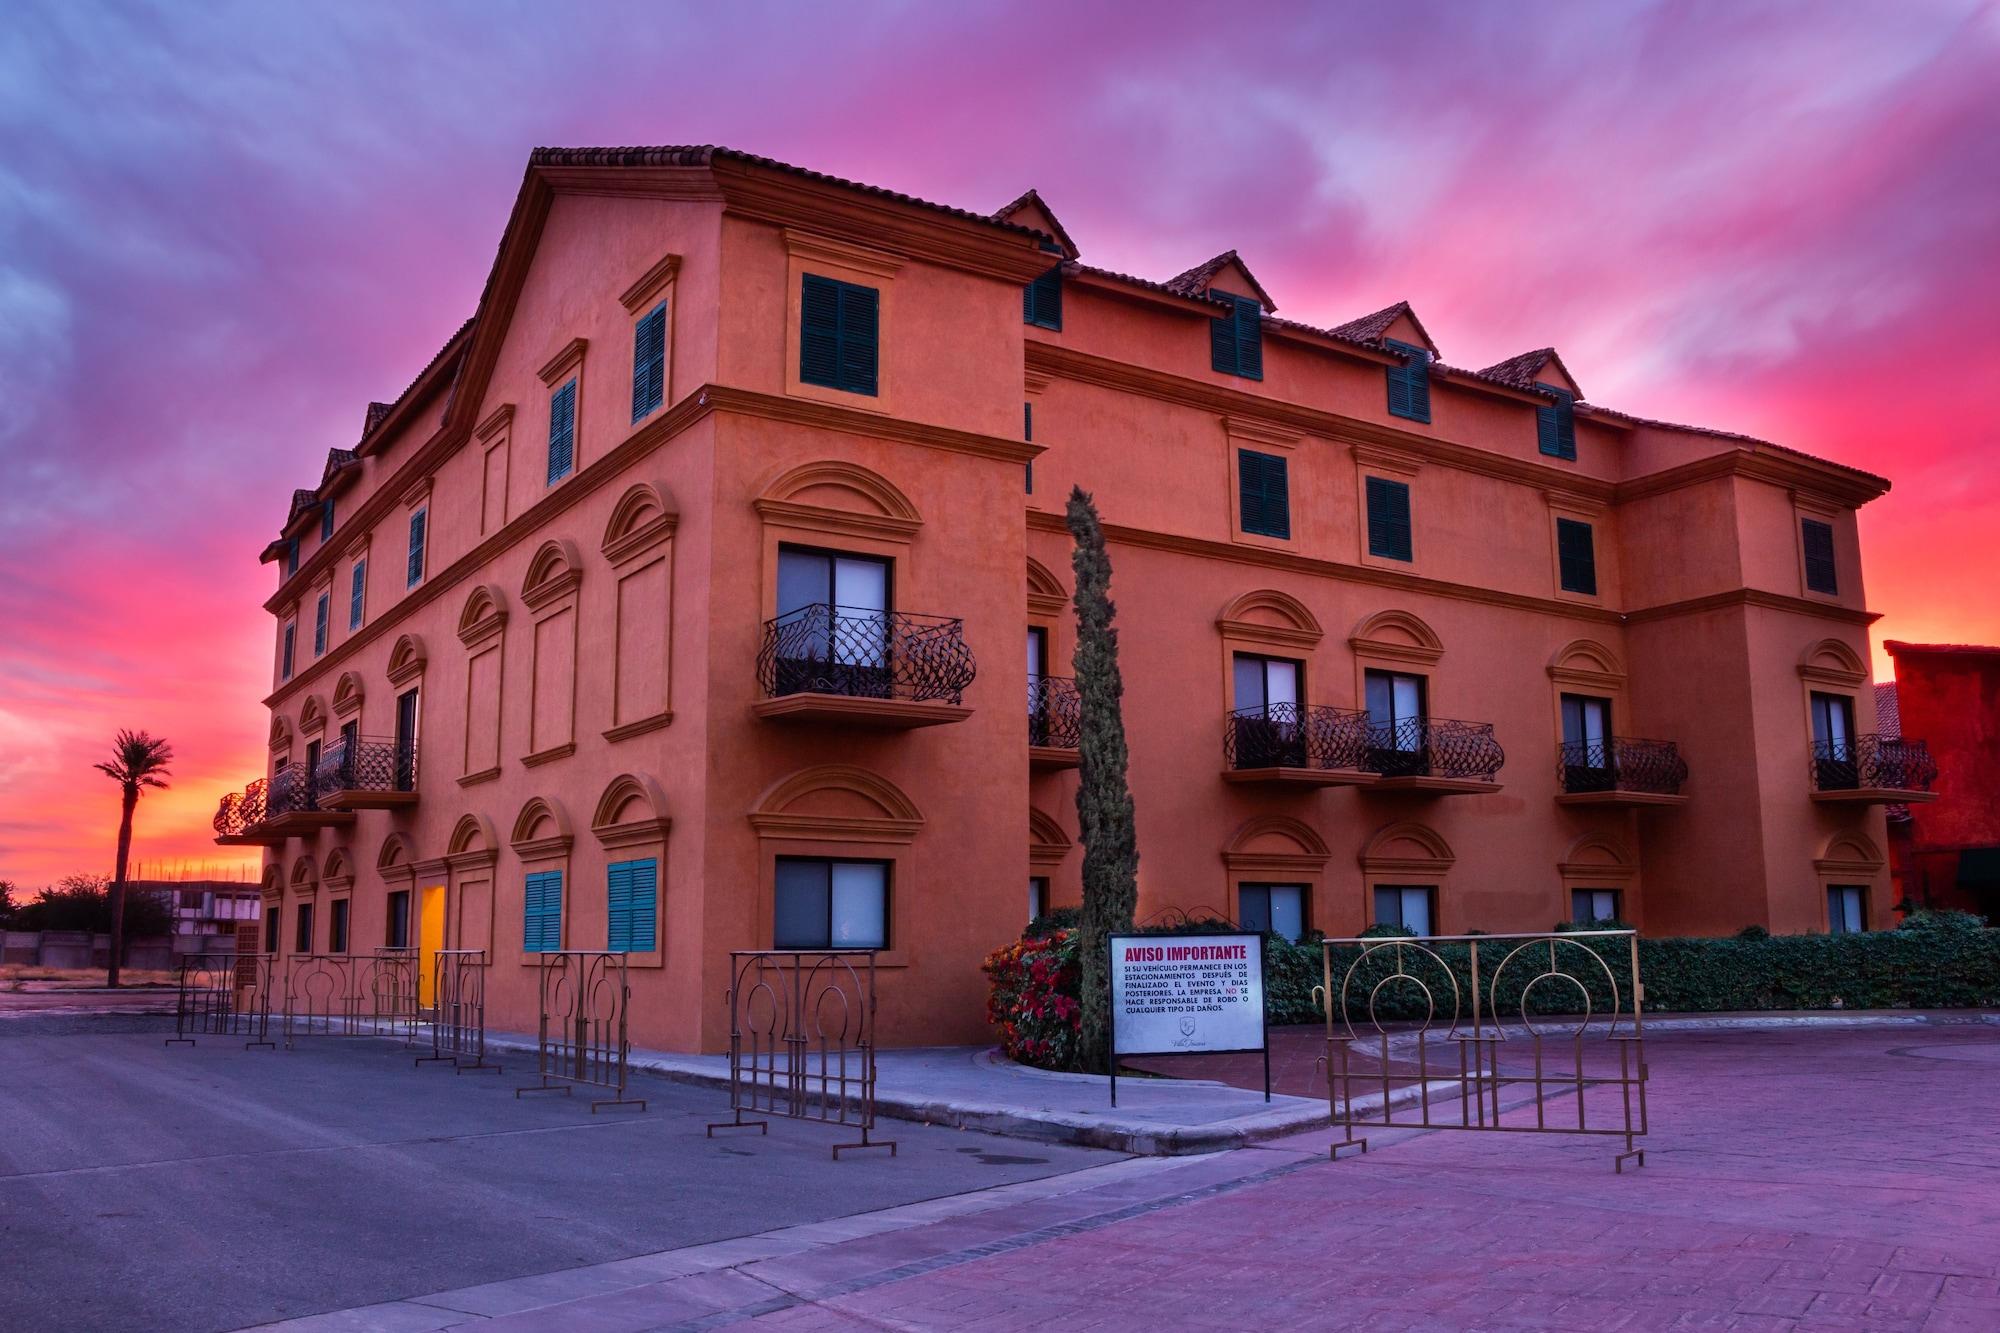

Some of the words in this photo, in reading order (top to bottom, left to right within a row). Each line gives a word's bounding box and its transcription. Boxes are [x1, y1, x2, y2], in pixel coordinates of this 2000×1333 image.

[1125, 947, 1163, 961] AVISO
[1167, 945, 1246, 960] IMPORTANTE
[1126, 1006, 1165, 1014] CUALQUIER
[1197, 1004, 1223, 1012] DAÑOS.
